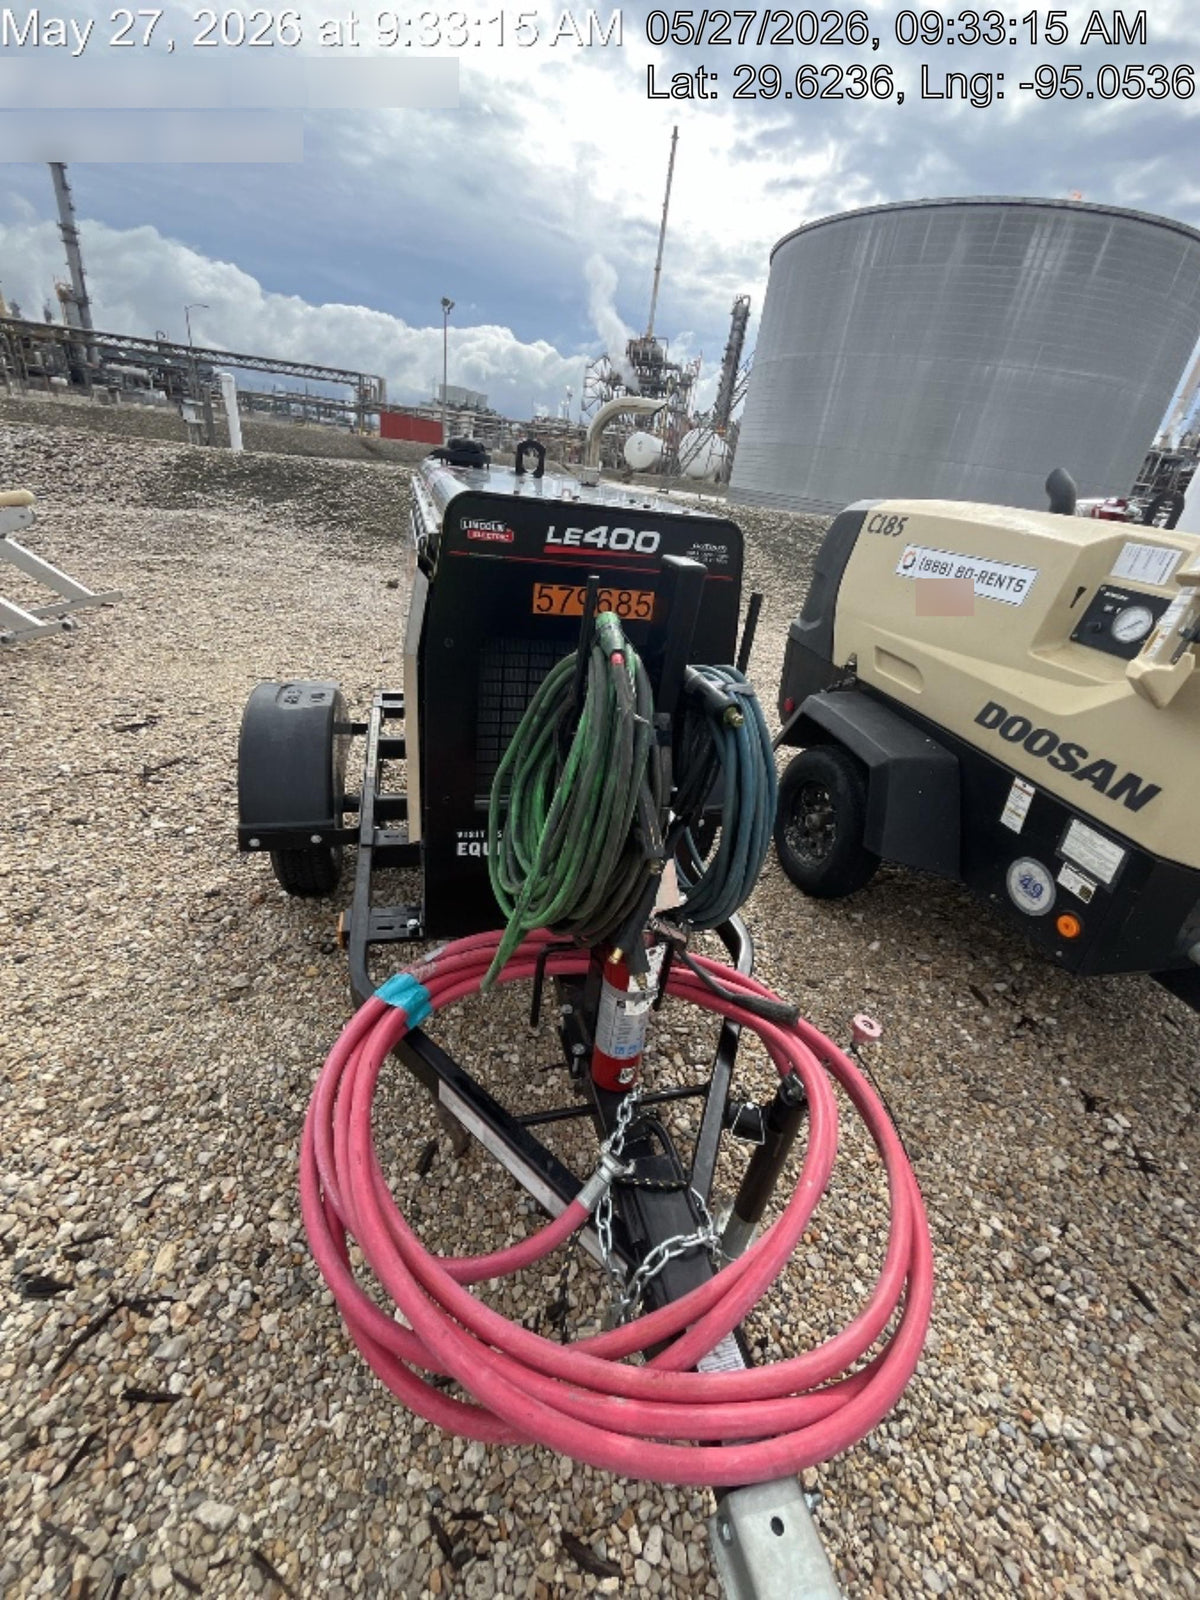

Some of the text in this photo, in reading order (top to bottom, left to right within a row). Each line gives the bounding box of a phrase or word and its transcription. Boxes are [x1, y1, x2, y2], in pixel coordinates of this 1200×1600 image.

[867, 513, 909, 537] C185
[545, 525, 661, 553] LE400
[919, 556, 954, 577] (888)
[974, 700, 1162, 813] DOOSAN
